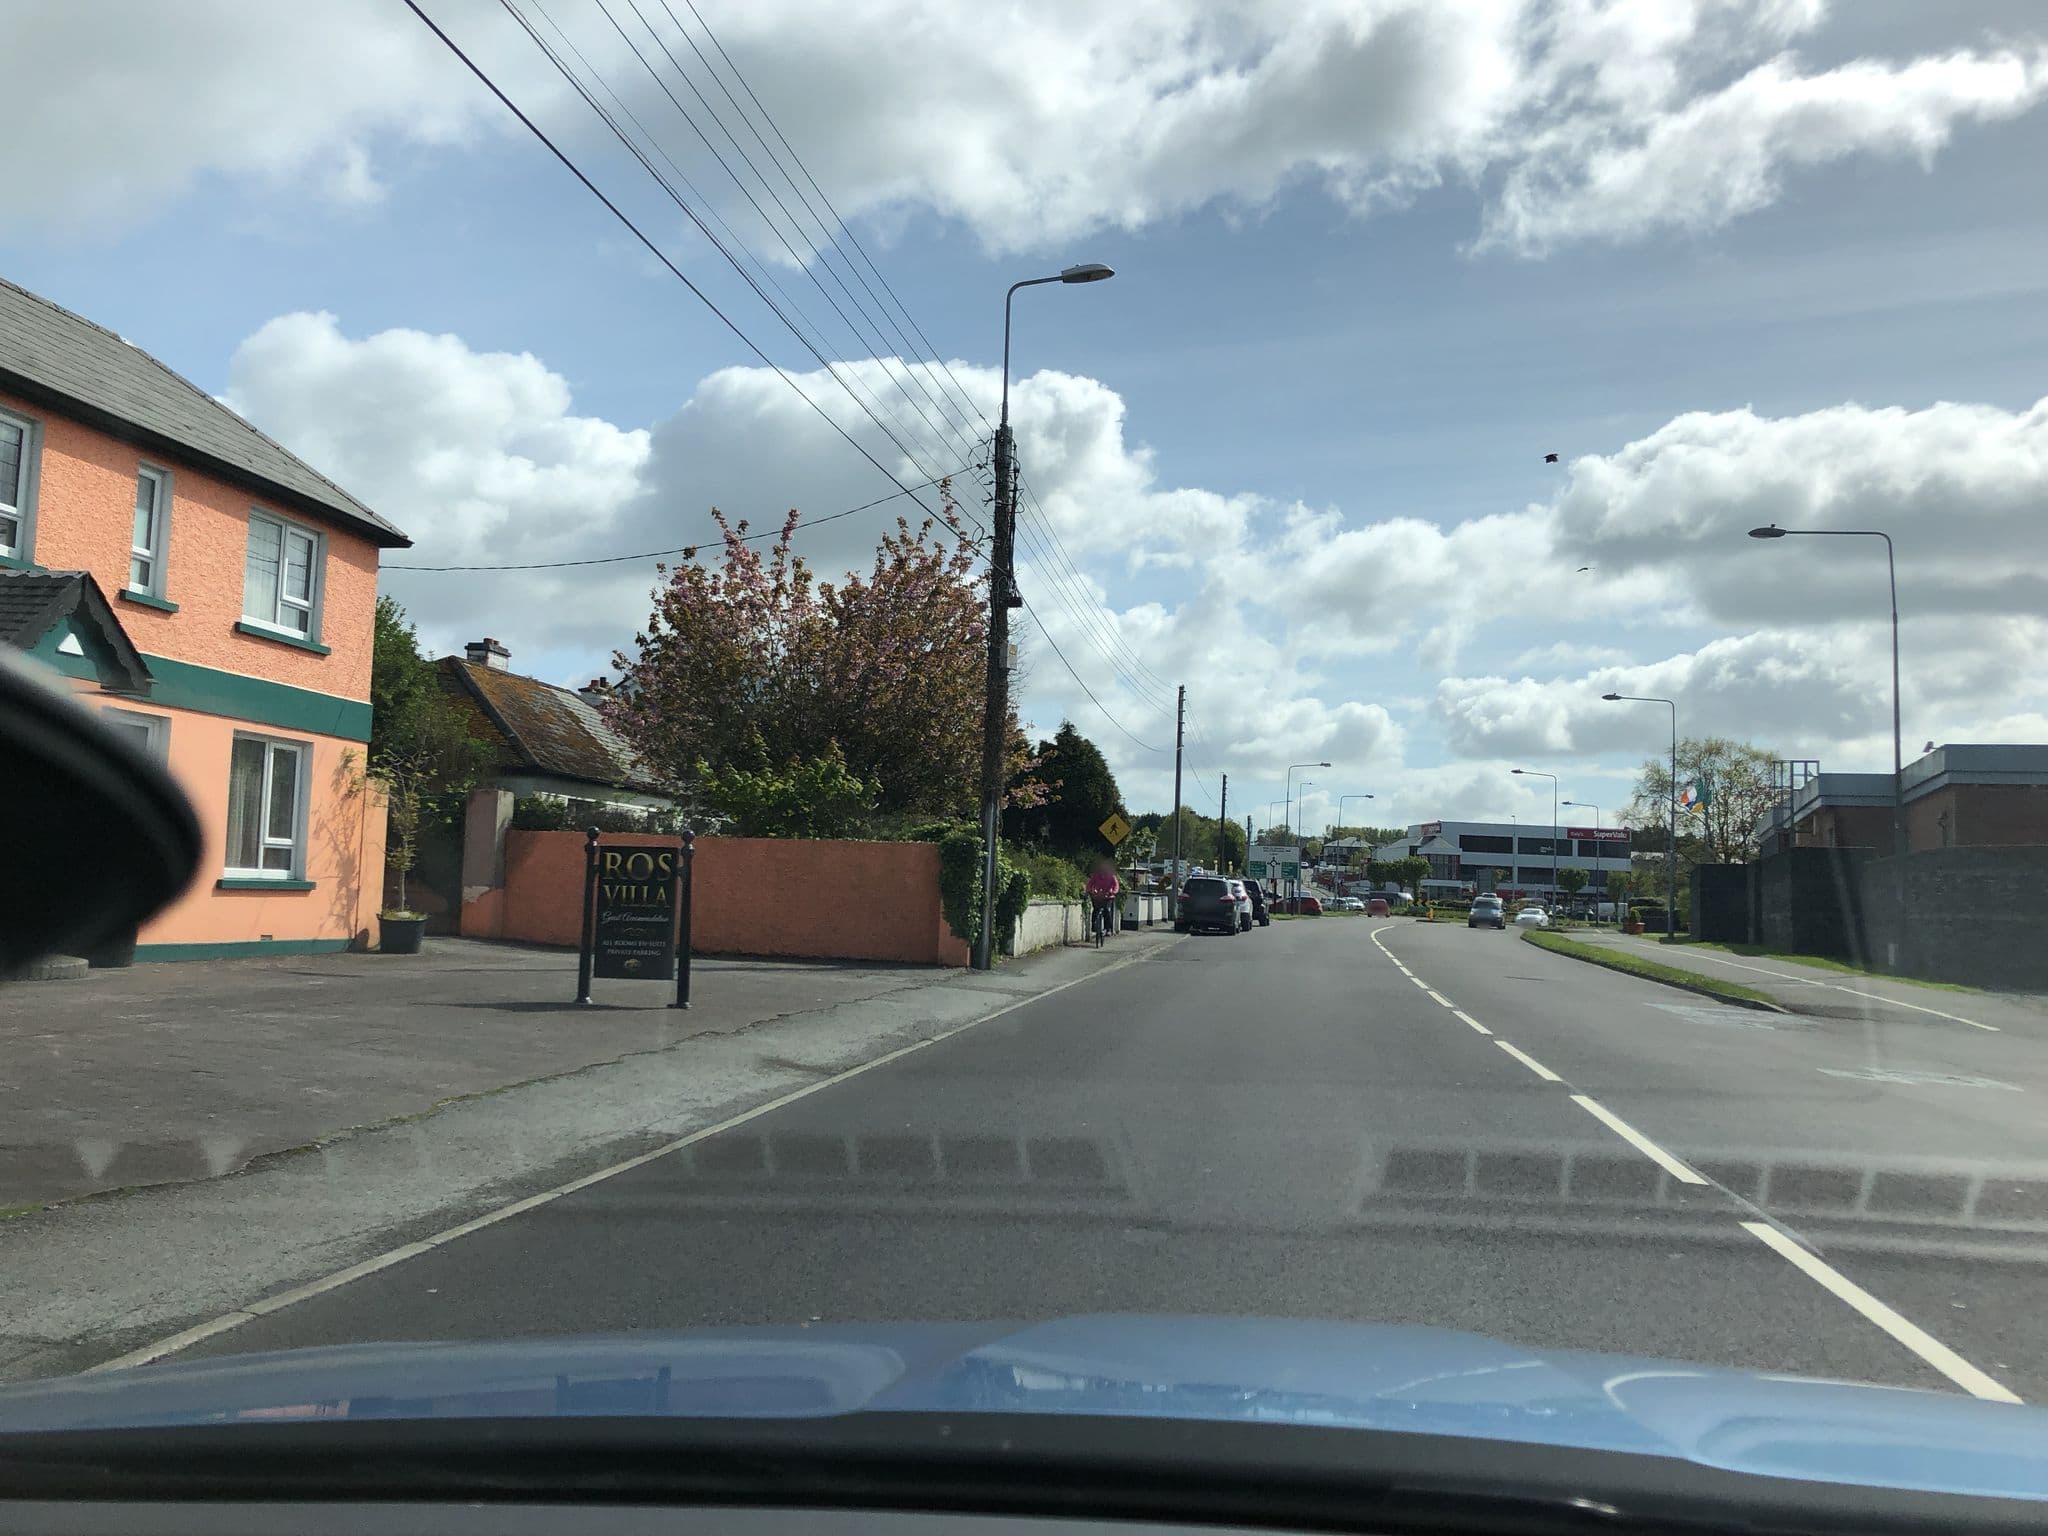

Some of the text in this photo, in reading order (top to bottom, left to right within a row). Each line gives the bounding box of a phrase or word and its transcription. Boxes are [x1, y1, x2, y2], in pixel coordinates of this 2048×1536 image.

[602, 852, 673, 880] ROS
[603, 884, 672, 908] VILLA
[614, 939, 637, 947] ROOMS
